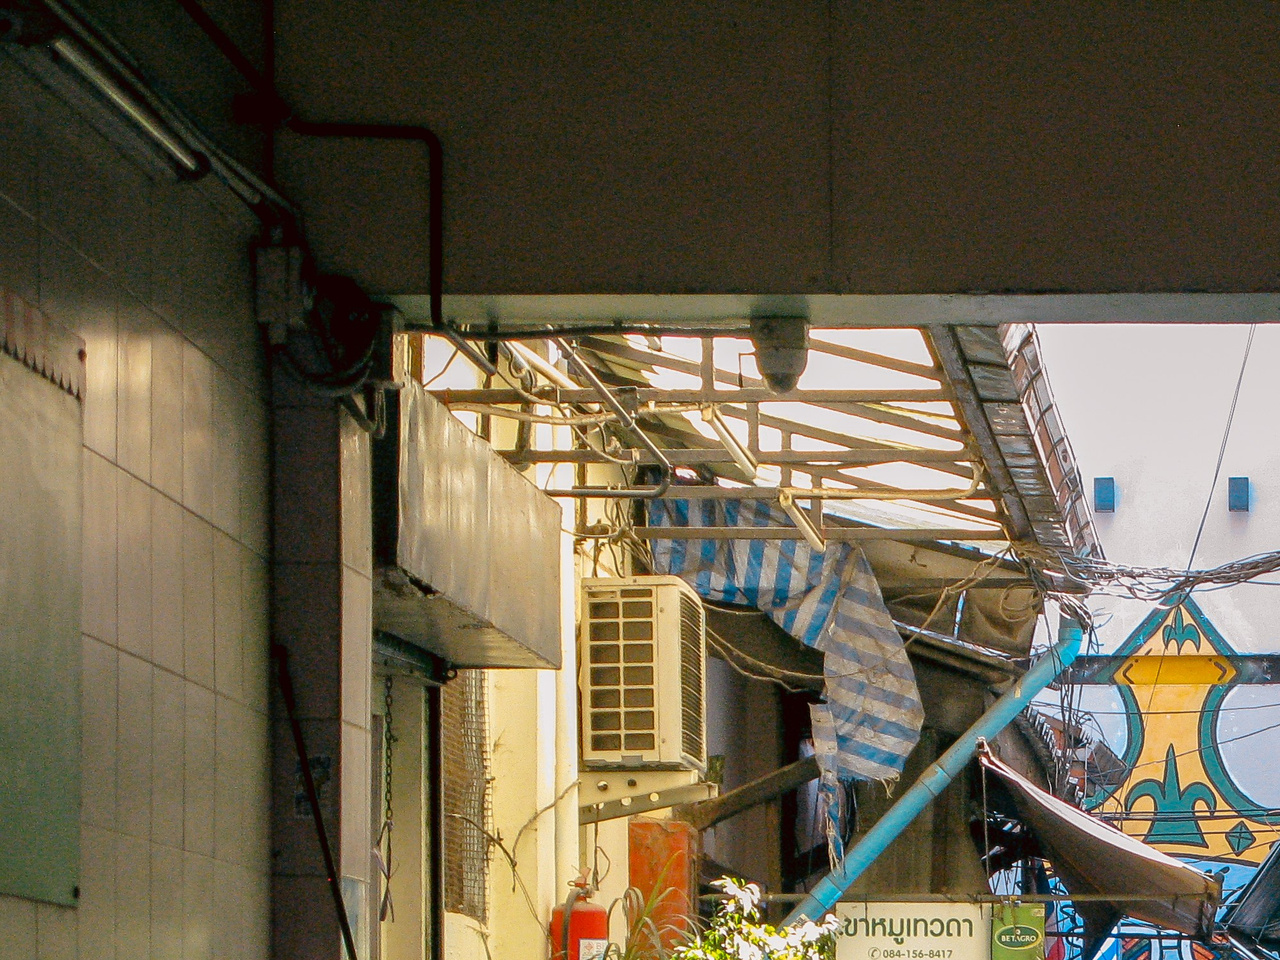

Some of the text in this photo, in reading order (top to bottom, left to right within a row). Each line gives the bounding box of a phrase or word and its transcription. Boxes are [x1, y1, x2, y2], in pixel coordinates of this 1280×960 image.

[843, 917, 974, 945] ขาหมูเทวดา
[1001, 934, 1037, 942] BETAGRO
[882, 949, 953, 959] 084-156-8417
